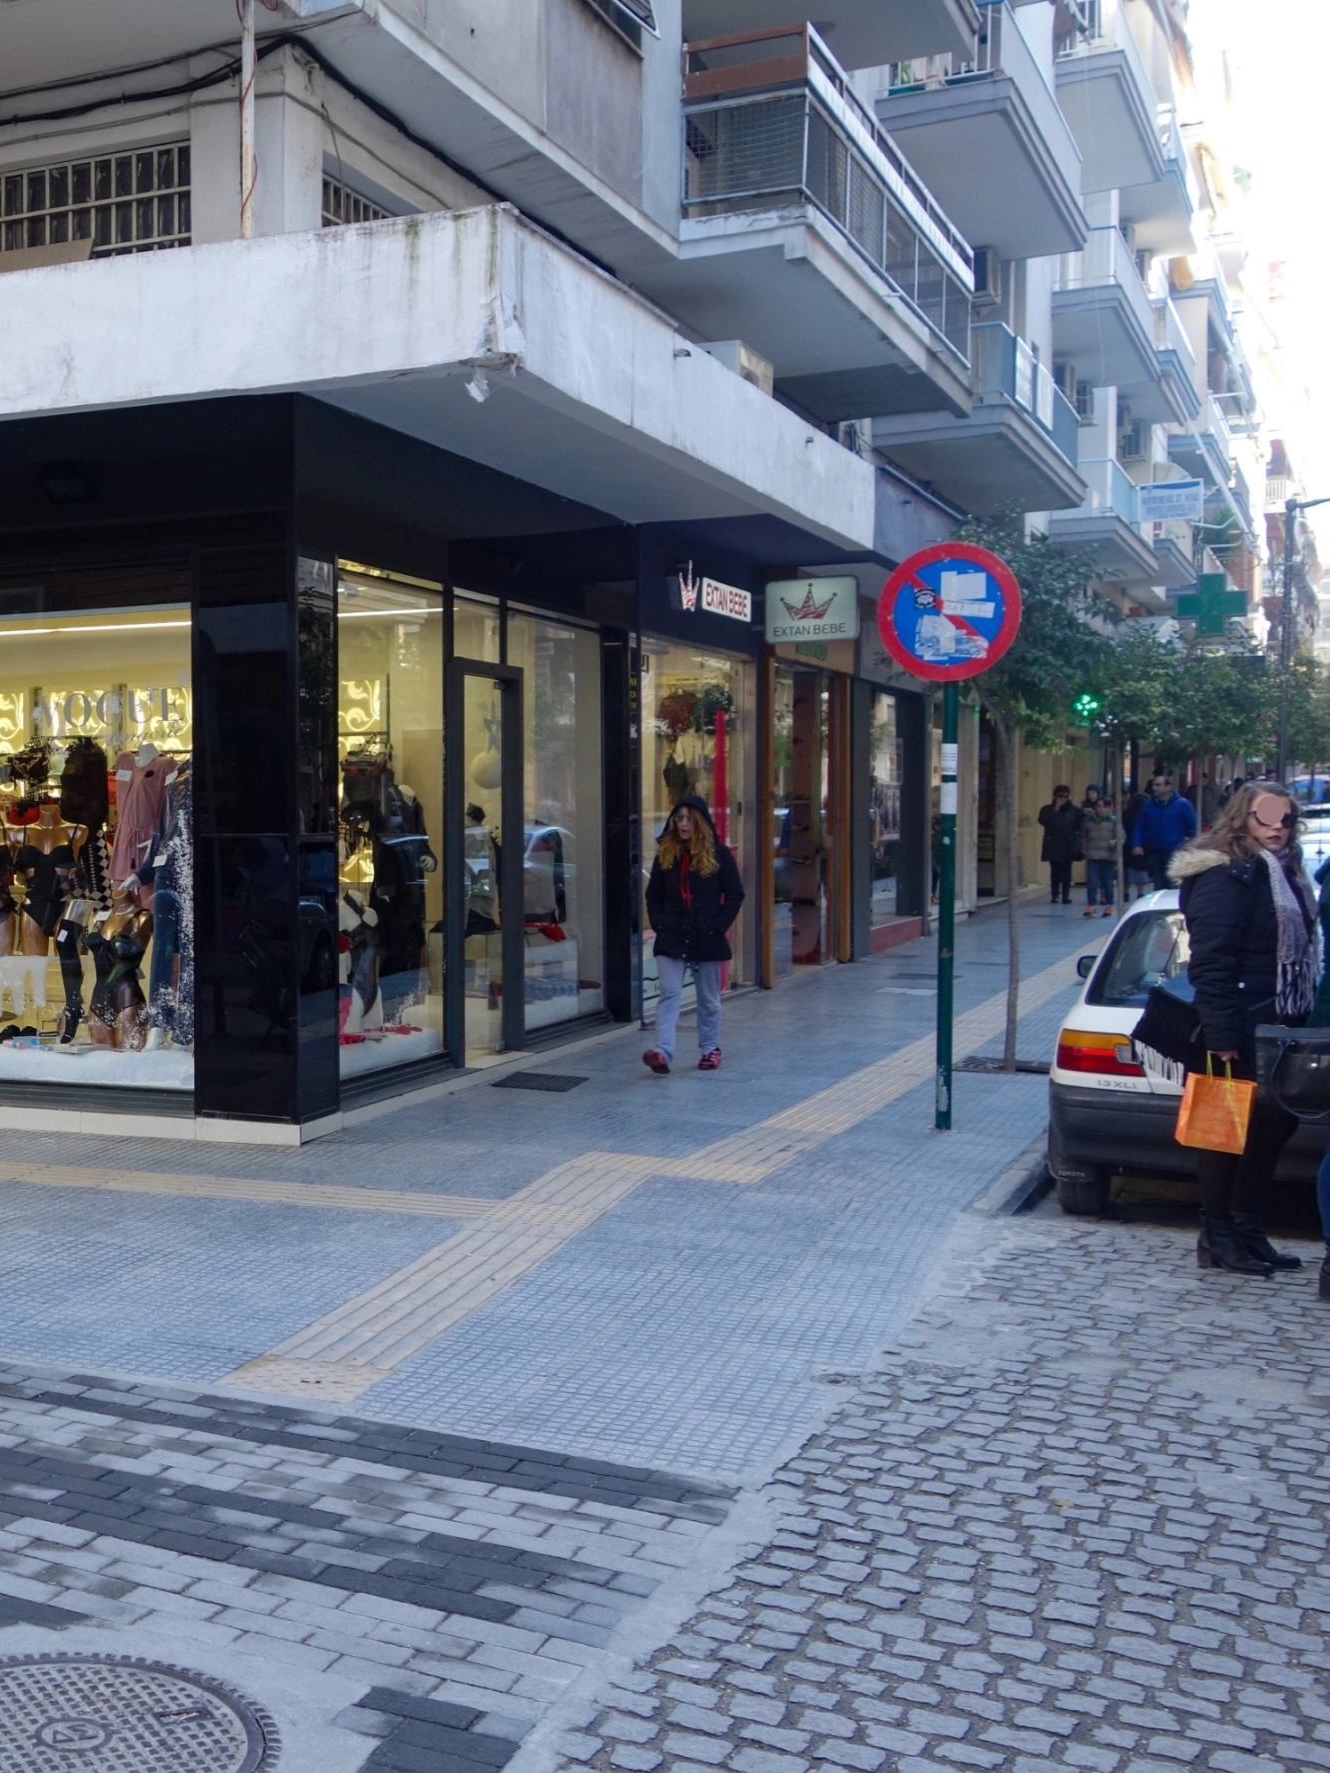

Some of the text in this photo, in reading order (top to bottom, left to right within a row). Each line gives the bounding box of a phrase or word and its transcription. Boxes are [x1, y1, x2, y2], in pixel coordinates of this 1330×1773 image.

[706, 582, 748, 618] EXTAN BEBE
[773, 623, 846, 637] EXTAN BEBE
[36, 687, 186, 729] VOGUE
